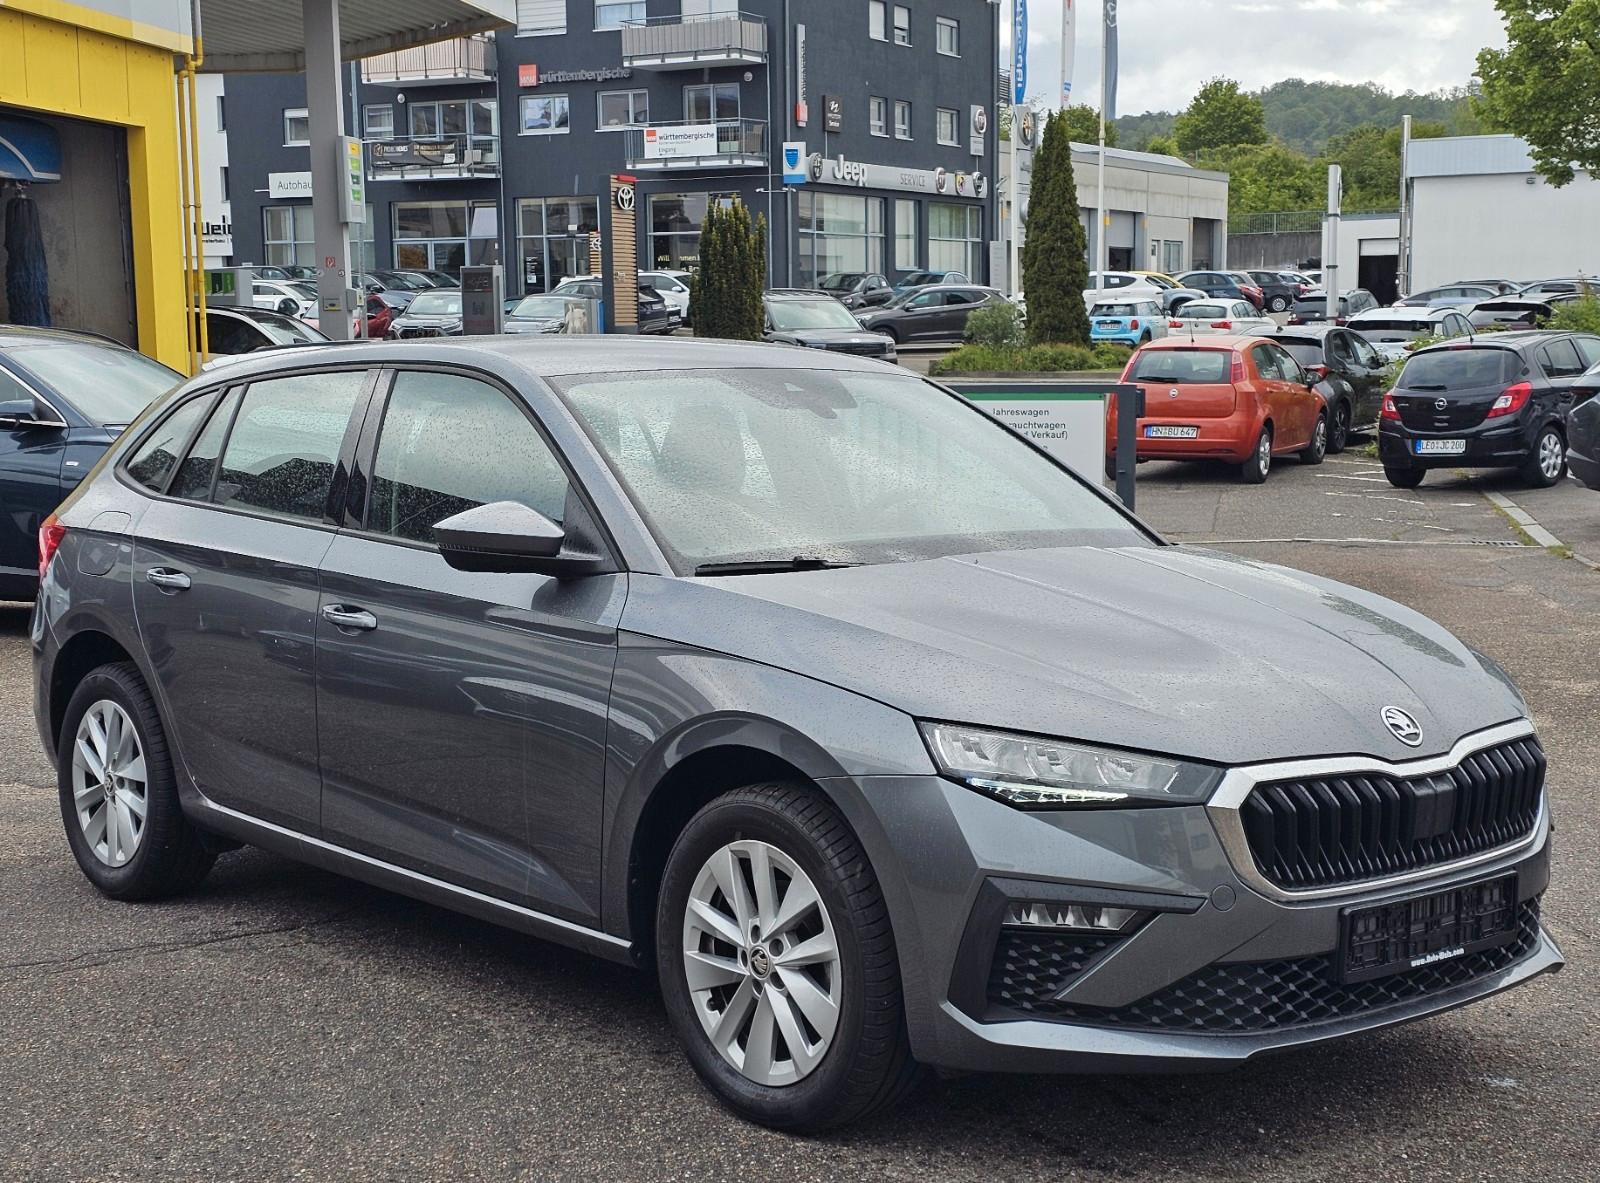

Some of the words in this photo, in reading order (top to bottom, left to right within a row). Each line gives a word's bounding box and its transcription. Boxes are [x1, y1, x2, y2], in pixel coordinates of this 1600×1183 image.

[540, 67, 631, 82] württembergische
[659, 131, 715, 141] württembergische
[832, 154, 868, 187] Jeep
[277, 180, 313, 190] Autohau
[900, 173, 925, 187] SERVICE
[1030, 431, 1068, 440] Verkauf)
[1167, 427, 1179, 436] BU
[1180, 428, 1196, 437] 647
[1422, 440, 1435, 450] LEO
[1439, 440, 1449, 450] JC
